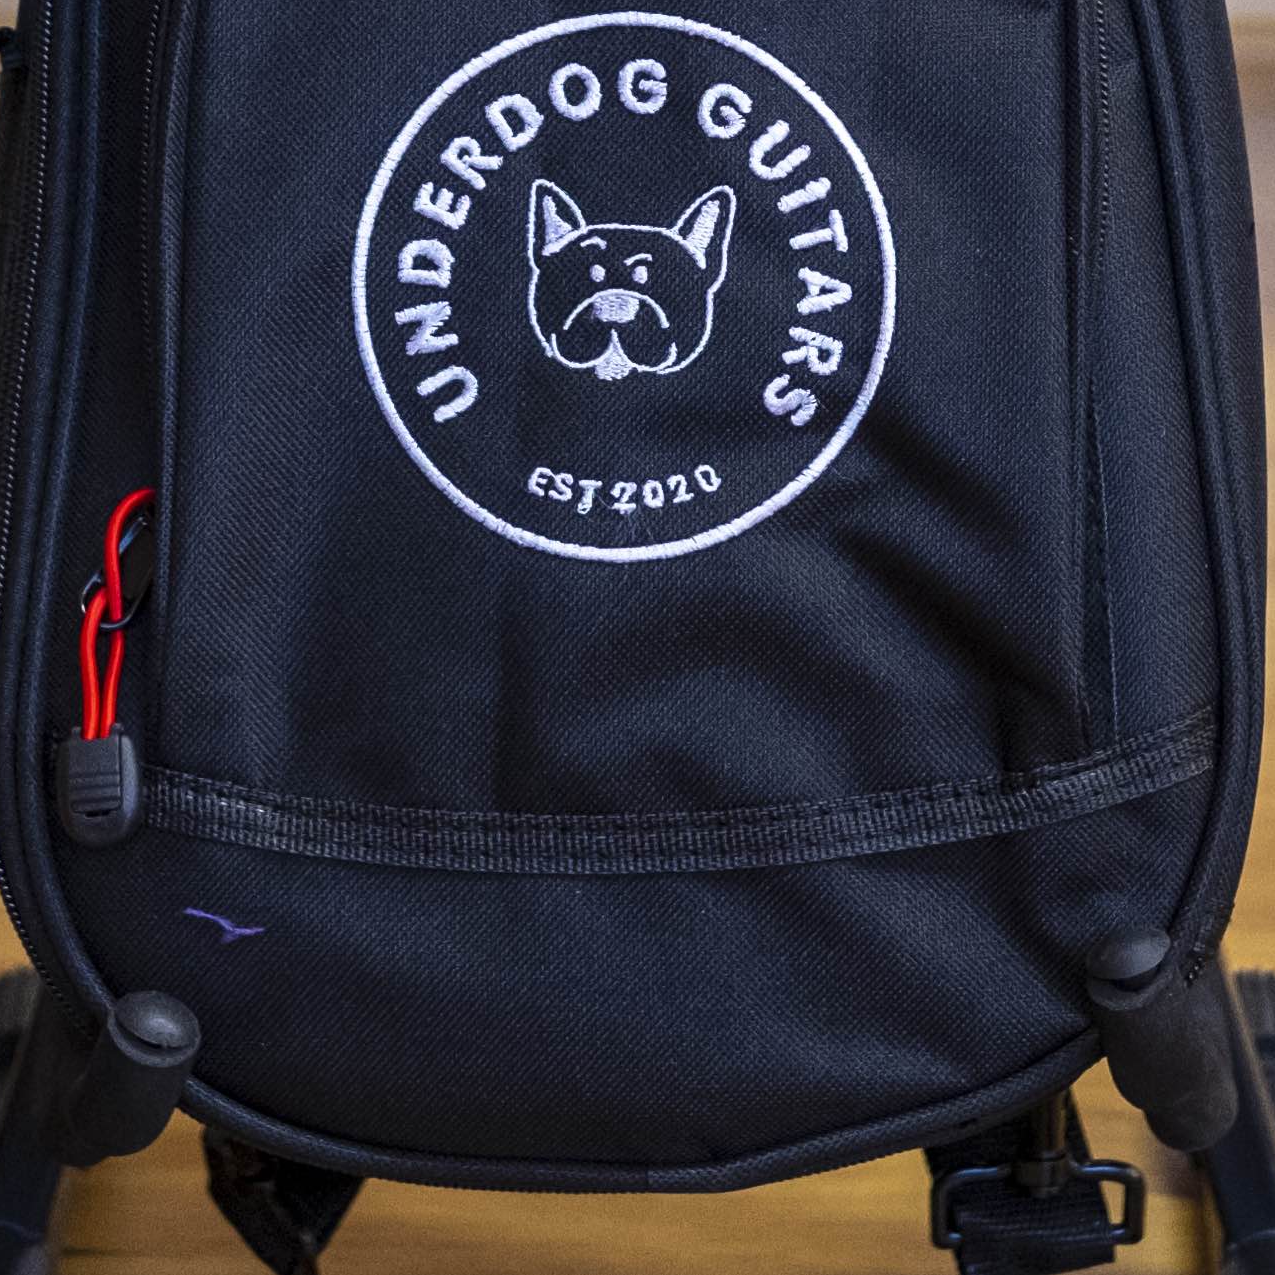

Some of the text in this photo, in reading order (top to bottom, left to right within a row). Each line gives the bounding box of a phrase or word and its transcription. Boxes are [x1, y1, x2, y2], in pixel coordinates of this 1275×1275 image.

[394, 57, 853, 427] UNDERDOG GUITARS
[527, 464, 723, 516] EST 2020
